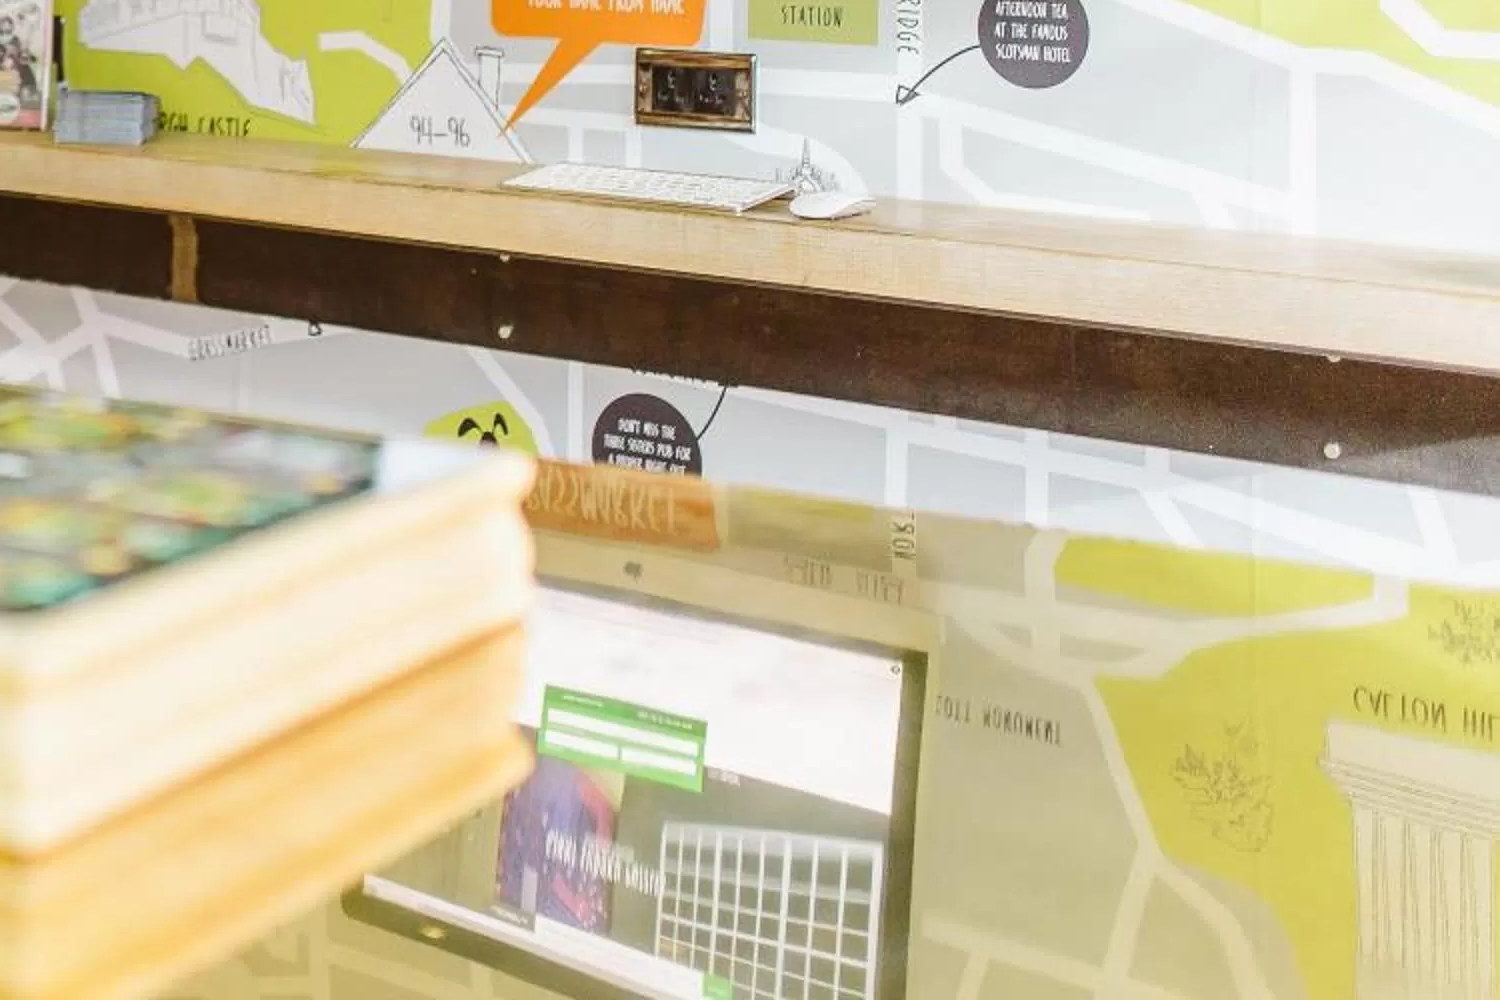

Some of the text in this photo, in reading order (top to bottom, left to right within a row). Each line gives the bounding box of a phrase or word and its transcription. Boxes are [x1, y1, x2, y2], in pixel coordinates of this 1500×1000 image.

[781, 4, 844, 28] STATION
[1052, 3, 1068, 19] TEA
[995, 22, 1068, 40] AT THE FAMOUS
[996, 43, 1070, 63] SCOTSMAN HOTEL
